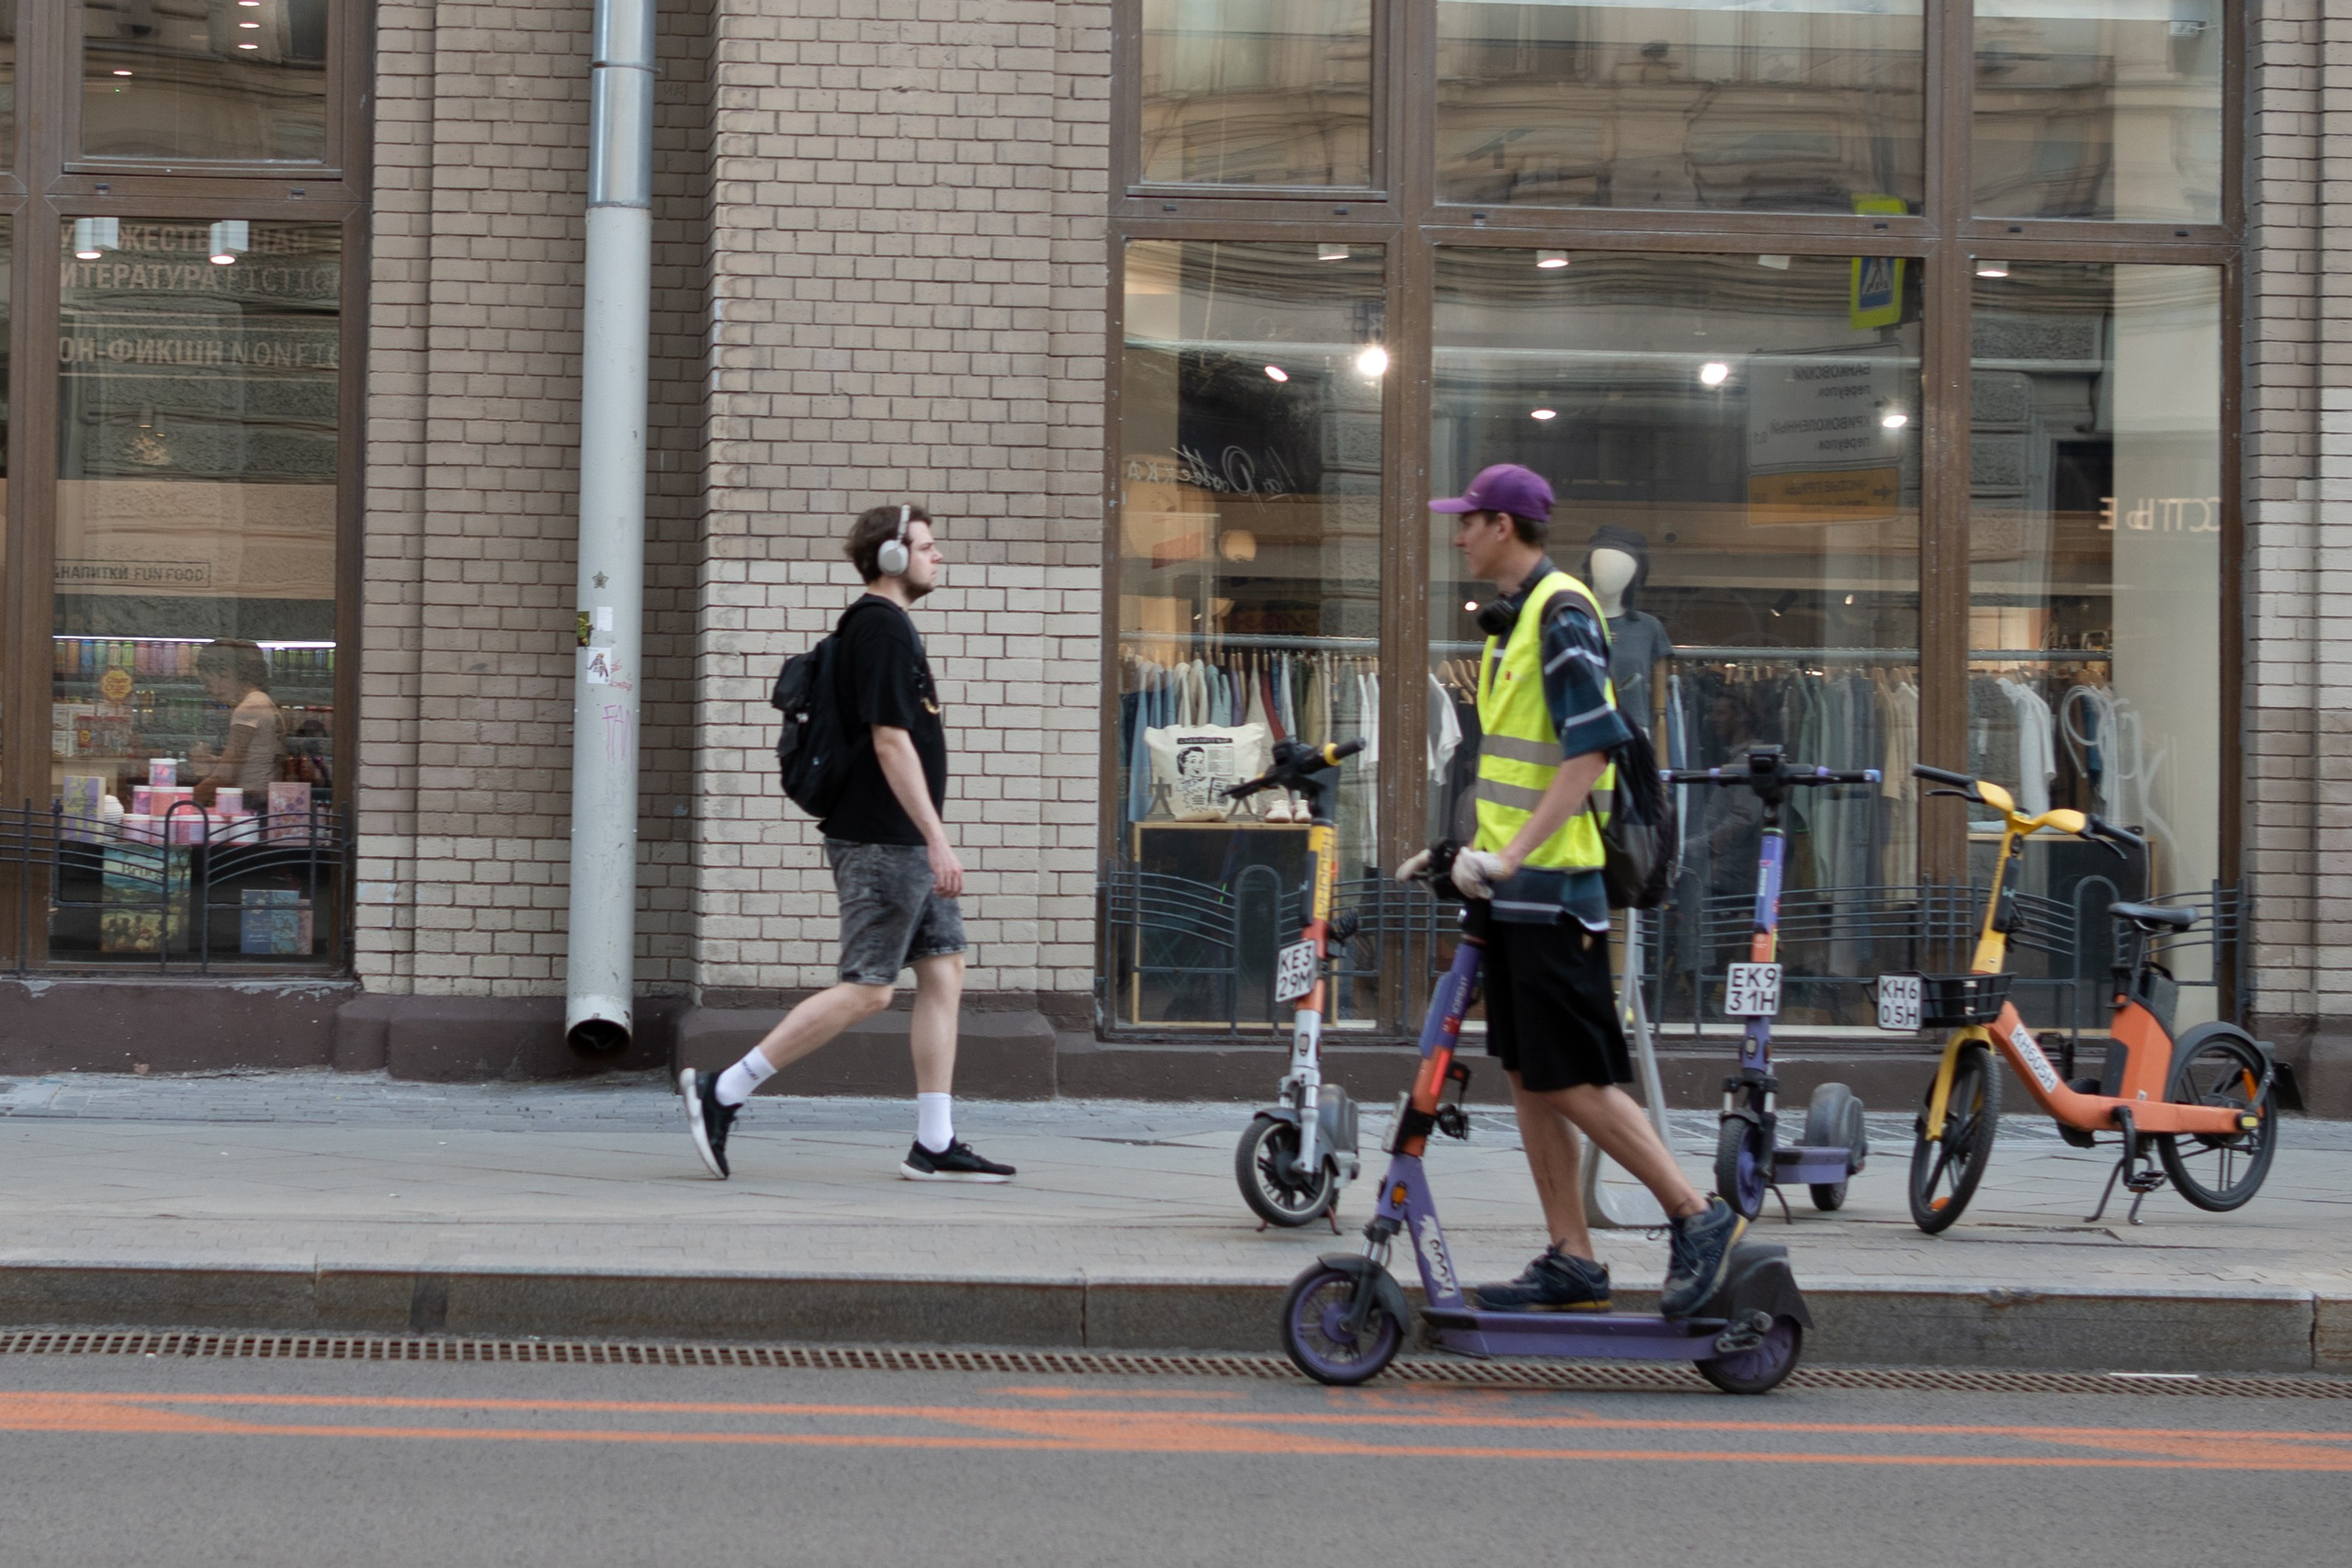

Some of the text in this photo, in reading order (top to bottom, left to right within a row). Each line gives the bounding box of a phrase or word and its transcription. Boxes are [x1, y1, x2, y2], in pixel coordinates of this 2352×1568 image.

[61, 262, 219, 290] ИТЕРАТУРА
[59, 336, 223, 366] ОН-ФИКШН
[1732, 967, 1778, 988] EK9
[1881, 979, 1917, 999] KH6
[1729, 990, 1776, 1011] 31H
